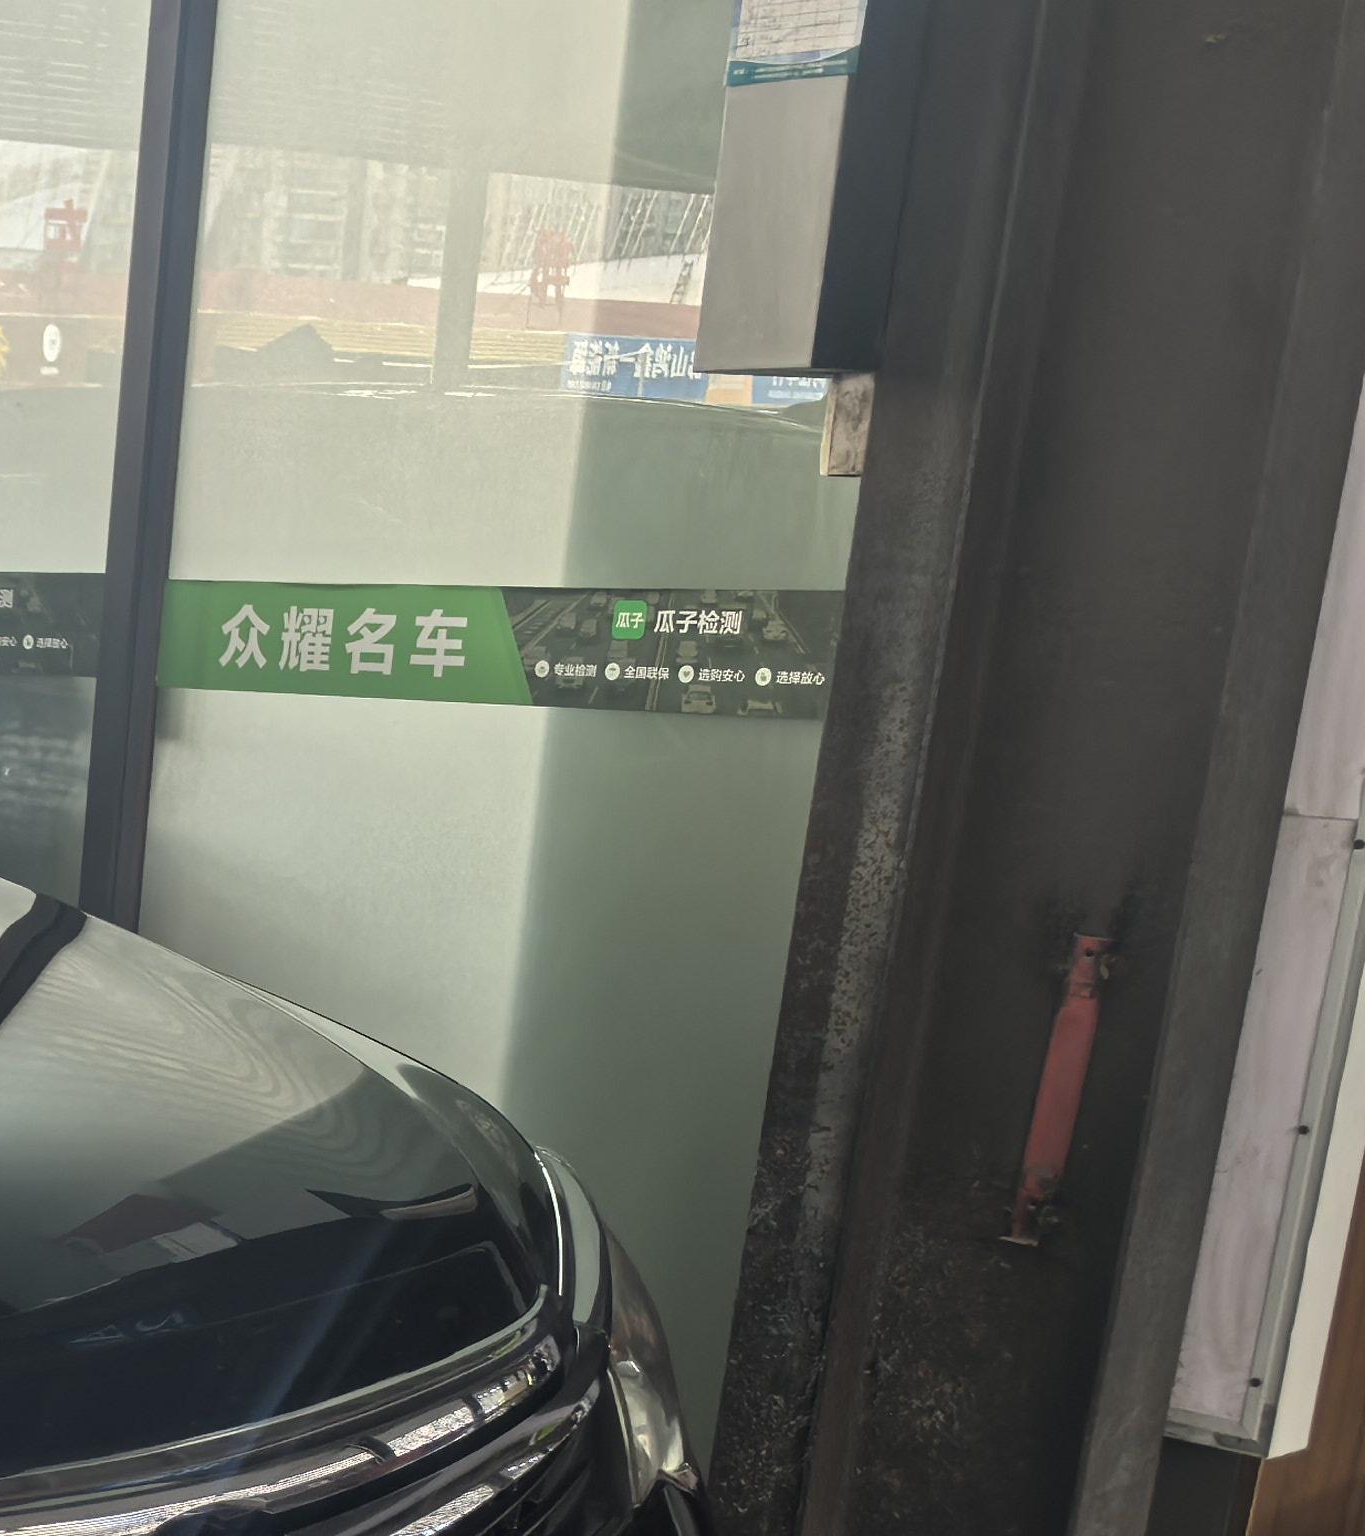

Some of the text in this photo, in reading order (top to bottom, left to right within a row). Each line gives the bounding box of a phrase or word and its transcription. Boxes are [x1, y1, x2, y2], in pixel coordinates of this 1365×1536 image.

[616, 609, 743, 635] 瓜子 瓜子检测
[218, 604, 468, 677] 众耀名车
[776, 669, 825, 686] 选择放心
